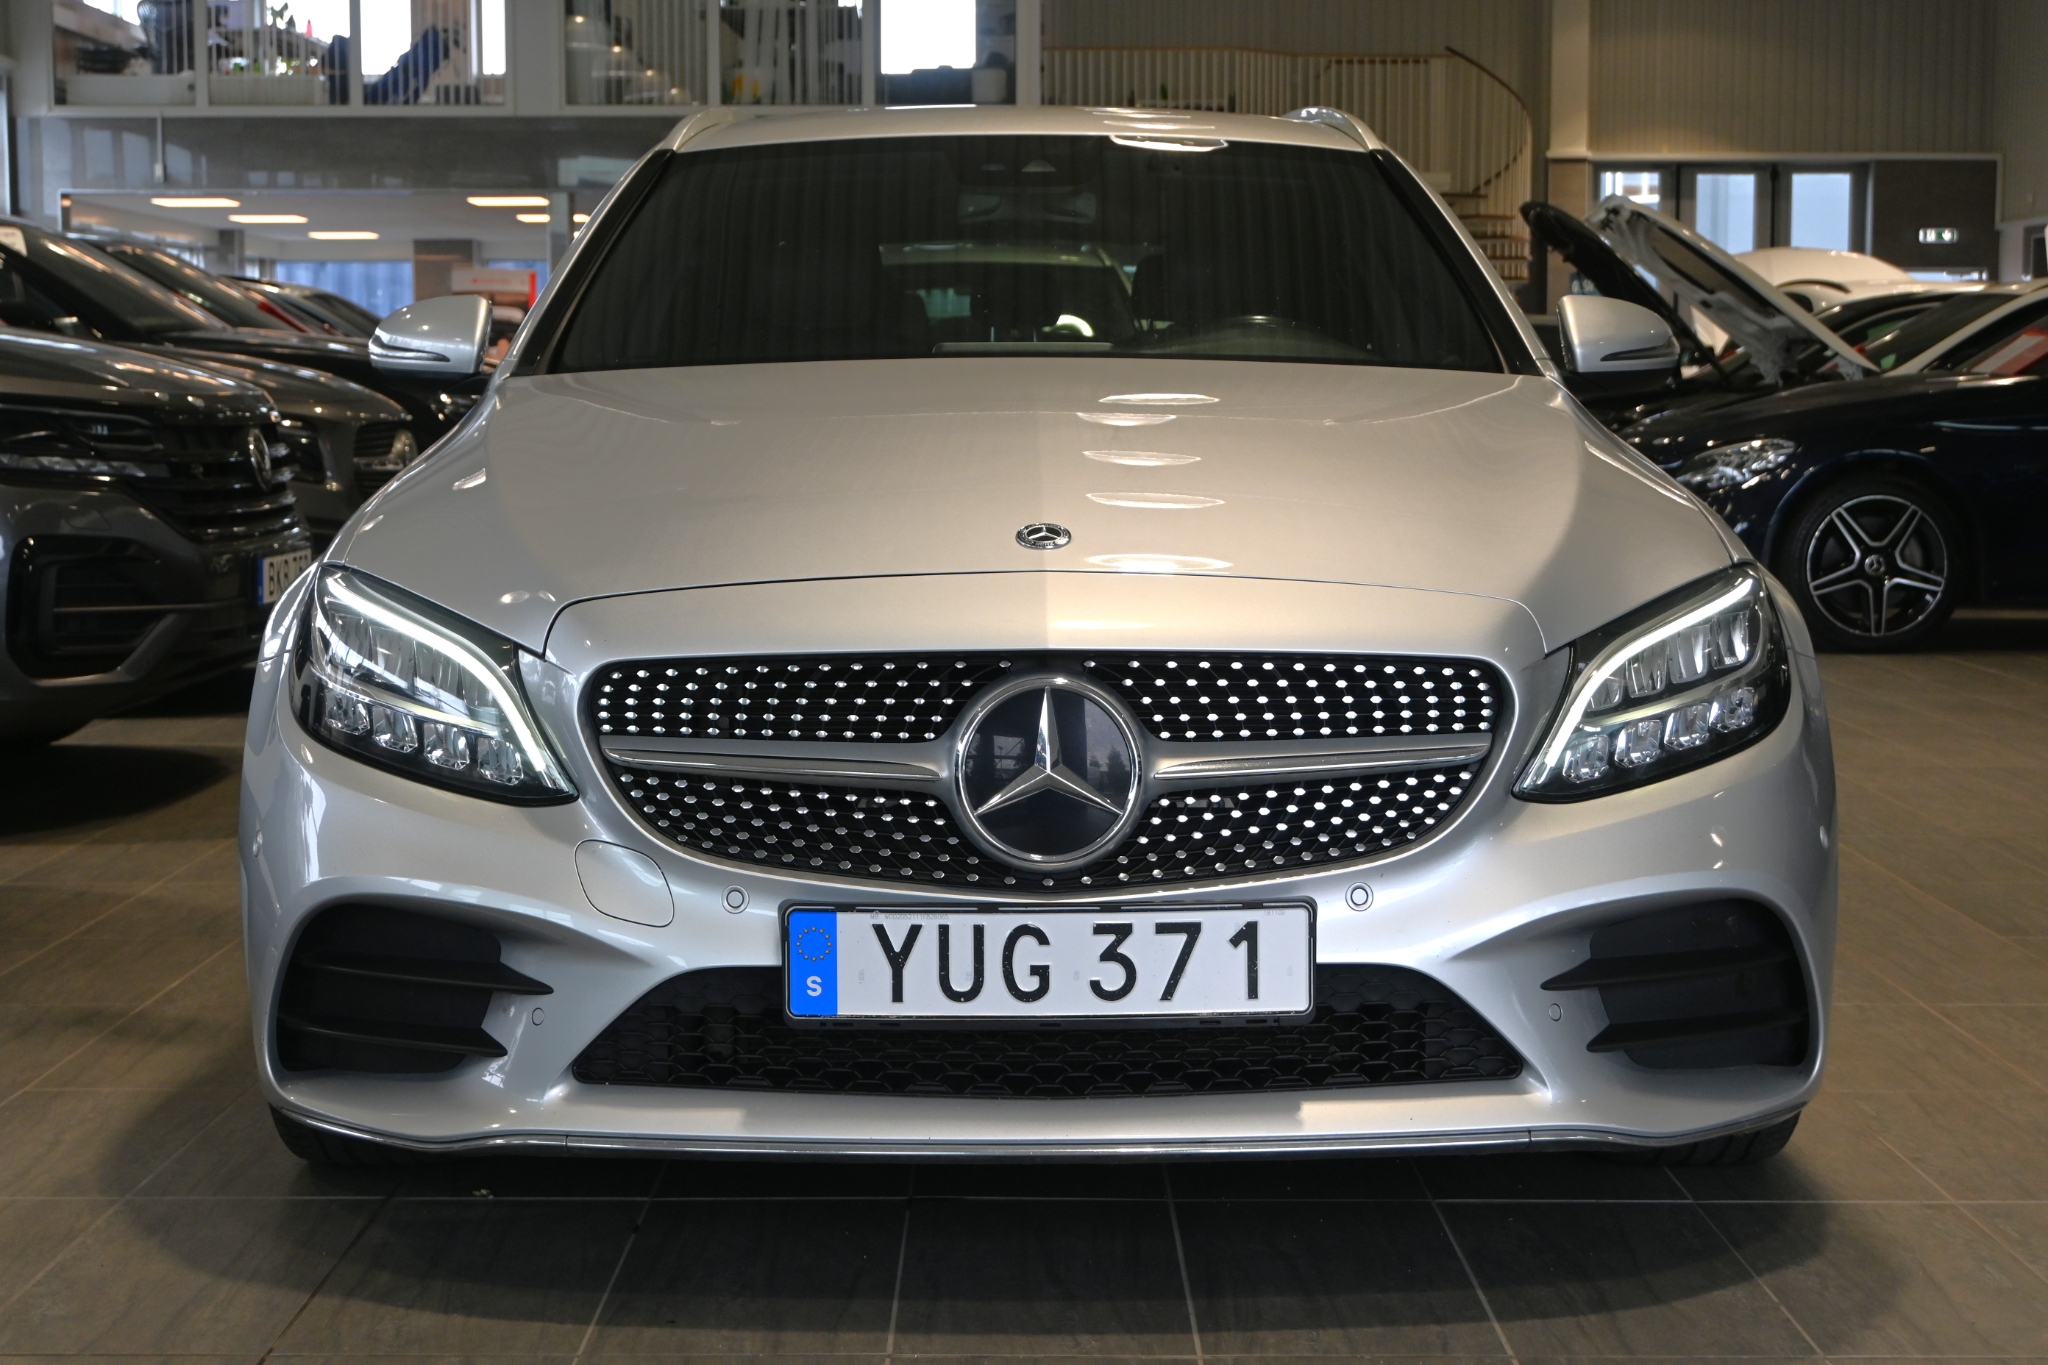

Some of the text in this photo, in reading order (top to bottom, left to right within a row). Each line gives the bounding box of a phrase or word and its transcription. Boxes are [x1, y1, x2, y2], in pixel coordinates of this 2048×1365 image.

[806, 975, 822, 997] S
[872, 920, 1259, 1003] YUG 371
